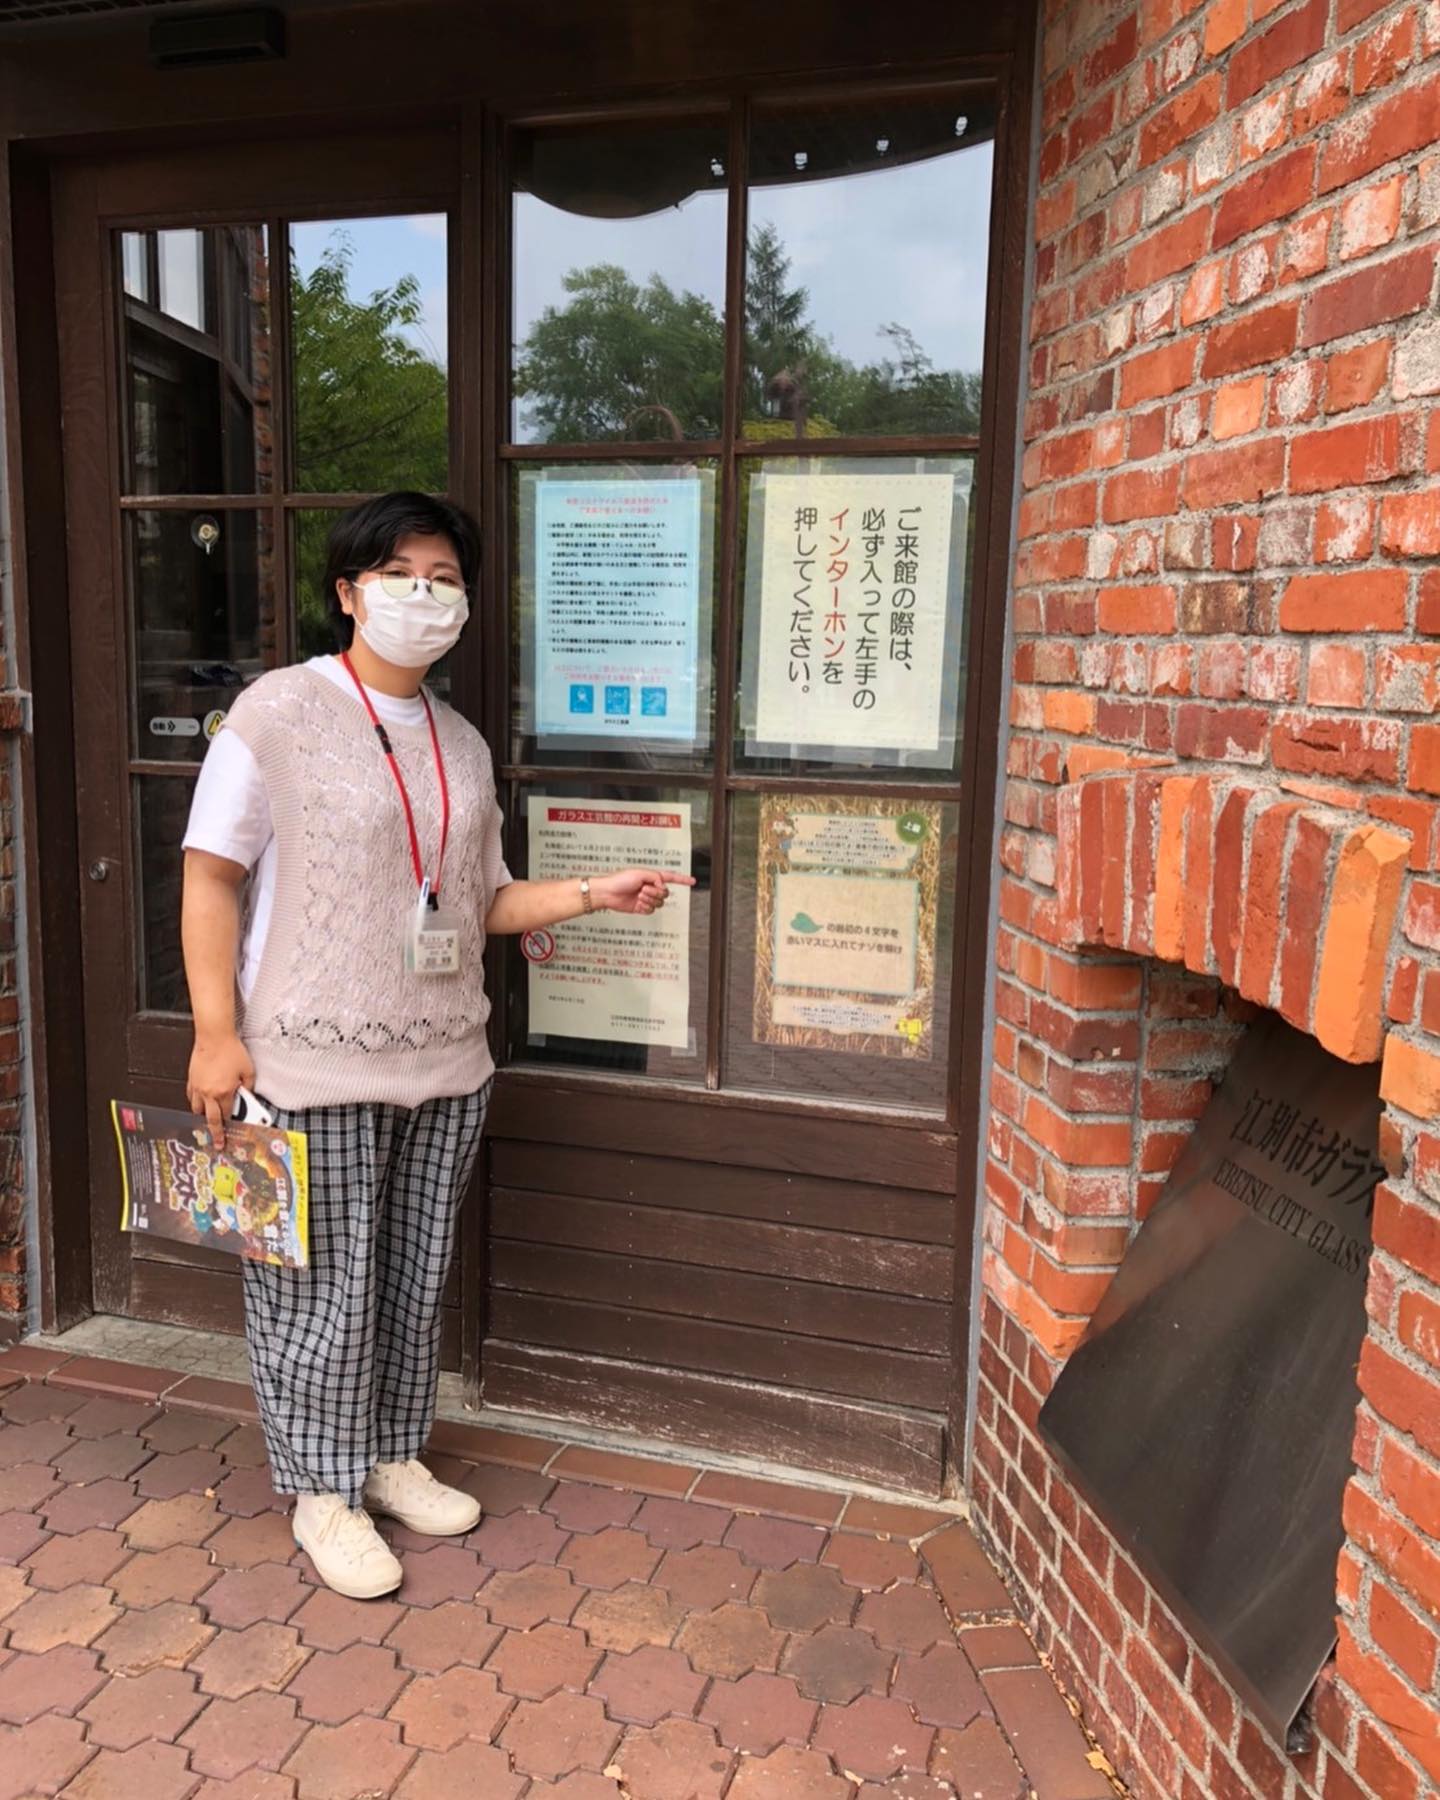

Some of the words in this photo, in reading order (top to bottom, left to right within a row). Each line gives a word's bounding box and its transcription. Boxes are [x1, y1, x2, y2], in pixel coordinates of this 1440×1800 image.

[788, 506, 817, 695] 押してください。
[821, 506, 849, 685] インターホンを
[852, 506, 887, 711] 必ず入って左手の
[889, 506, 921, 673] ご来館の際は、
[1212, 1158, 1274, 1213] EBETSU
[1268, 1192, 1313, 1236] CITY
[1308, 1220, 1368, 1275] GLASS
